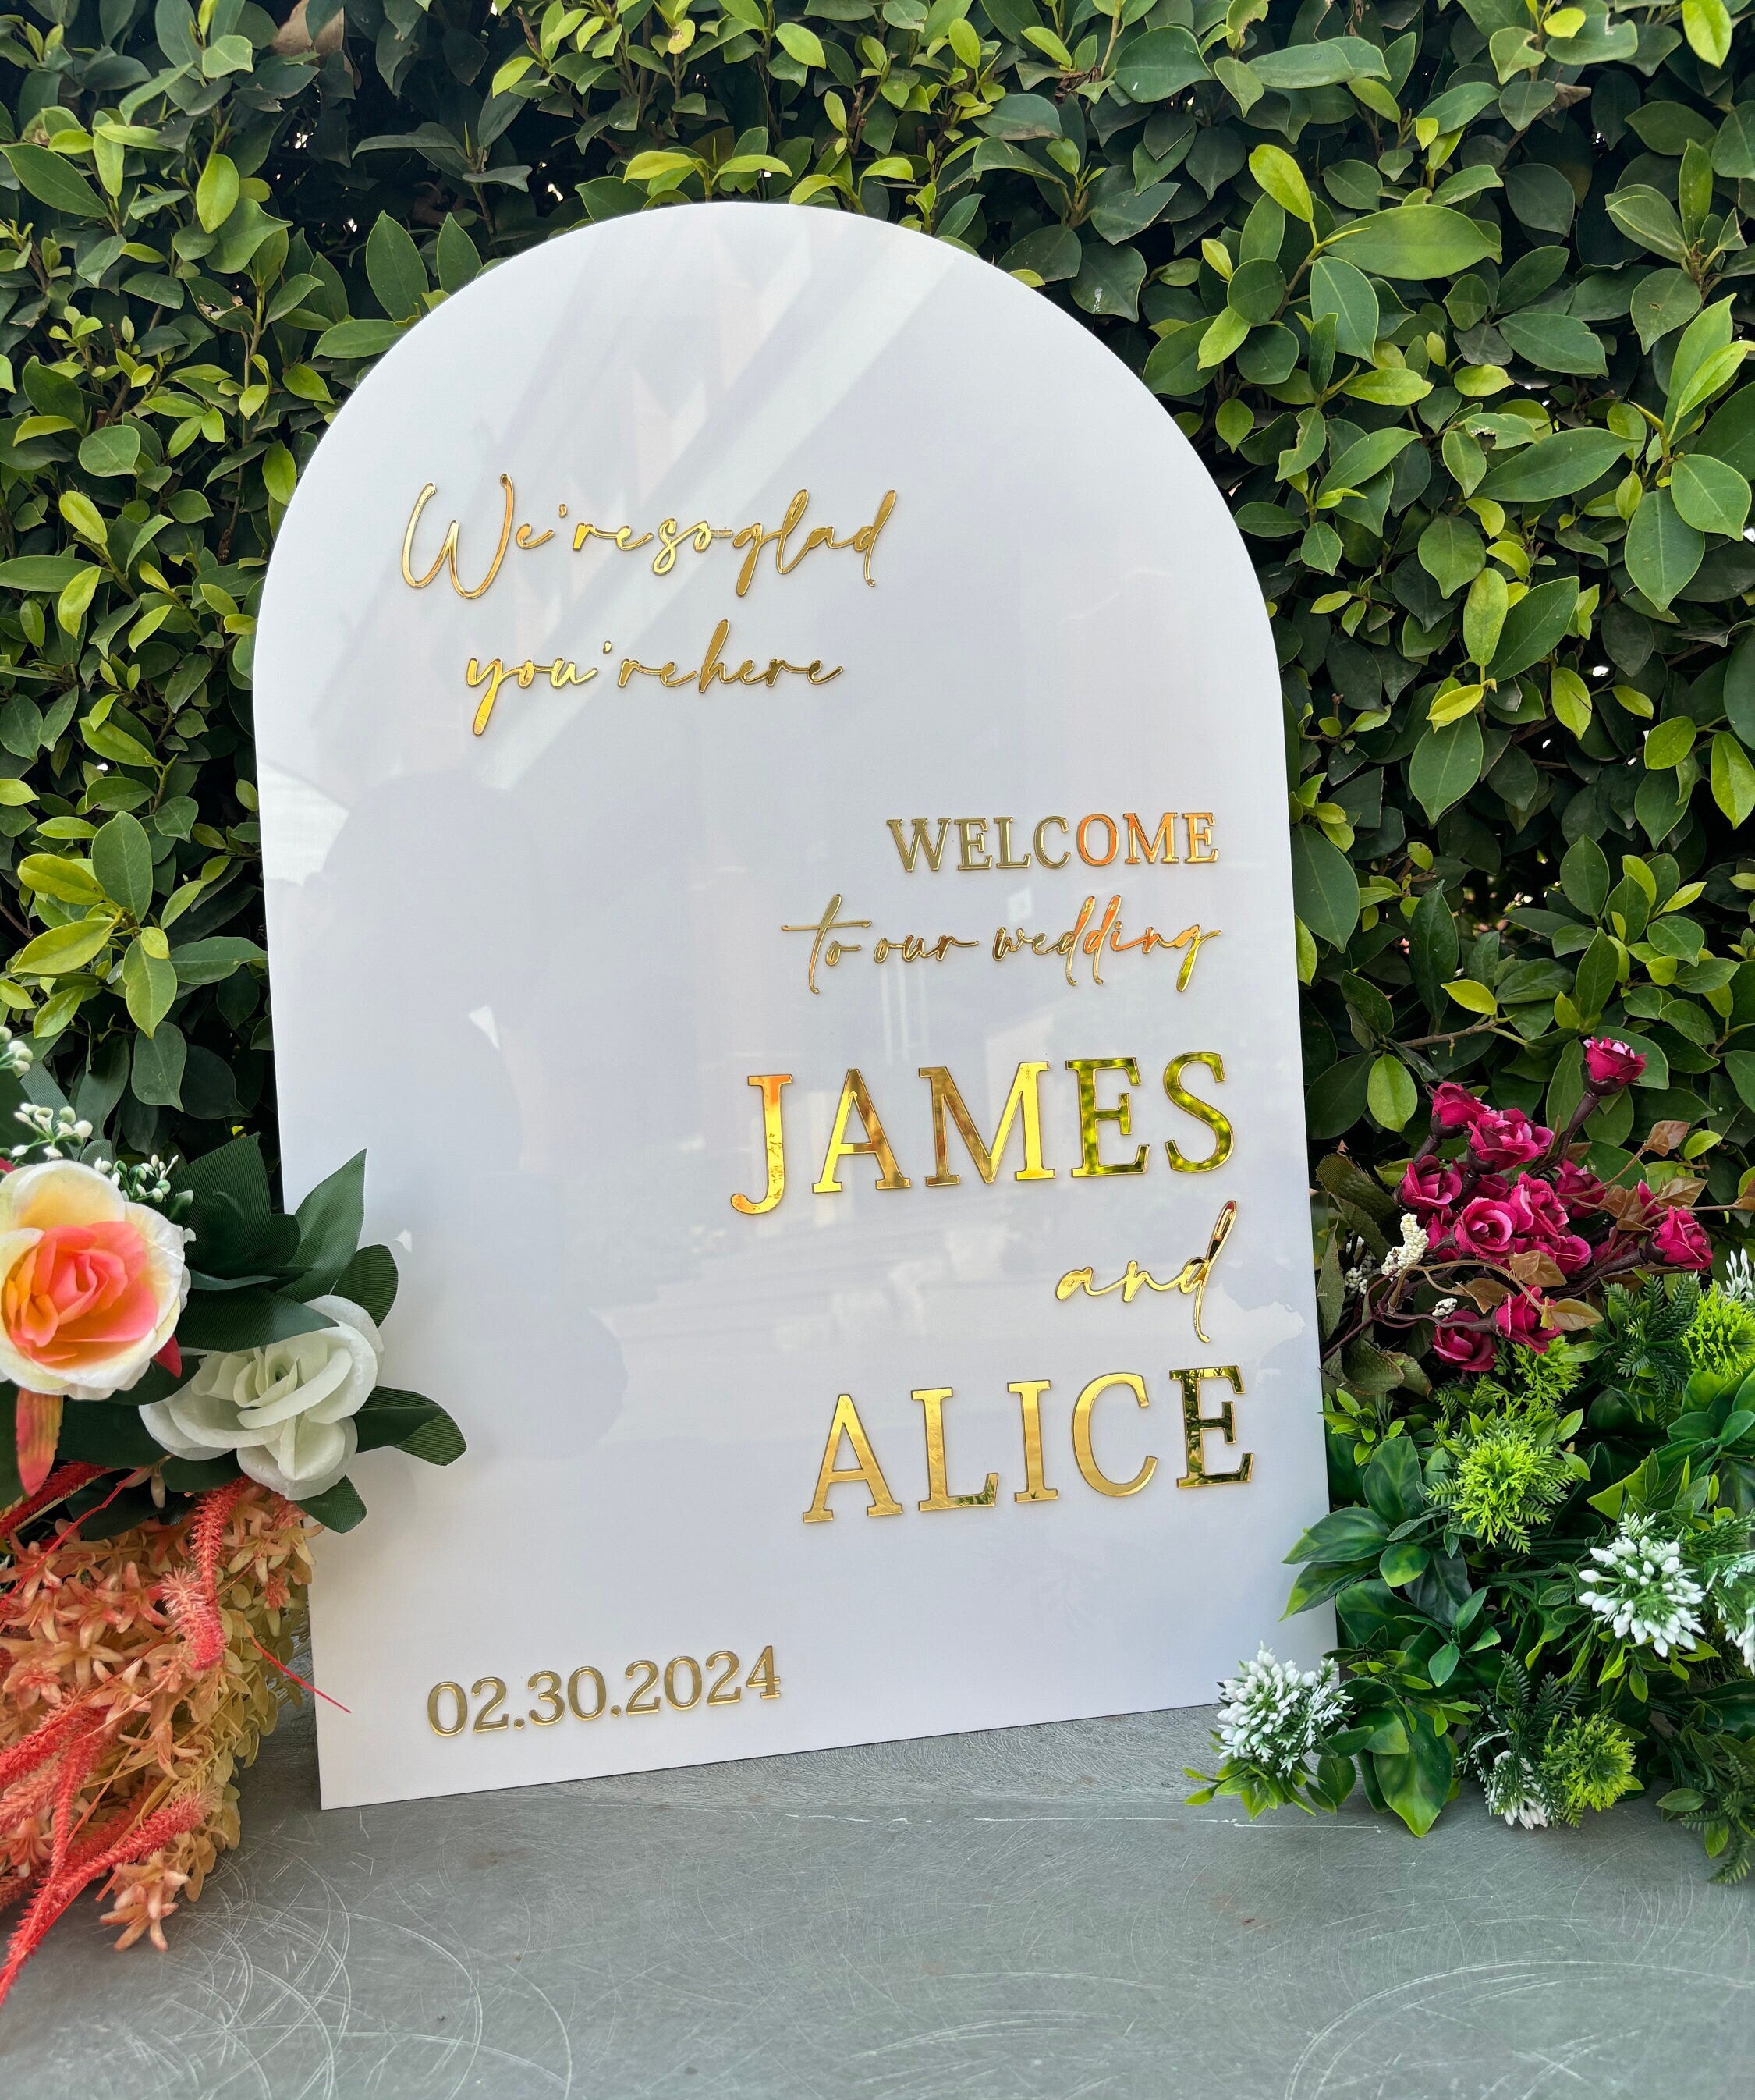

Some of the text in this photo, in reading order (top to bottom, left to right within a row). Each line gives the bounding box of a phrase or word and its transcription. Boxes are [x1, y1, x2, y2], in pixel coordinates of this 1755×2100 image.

[733, 489, 898, 597] glad
[465, 619, 845, 737] you're here
[886, 812, 1220, 873] WELCOME
[781, 894, 1223, 995] to our wedding
[730, 1051, 1236, 1215] JAMES
[1055, 1200, 1237, 1343] and
[802, 1365, 1255, 1524] ALICE
[427, 1644, 781, 1736] 02.30.2024
